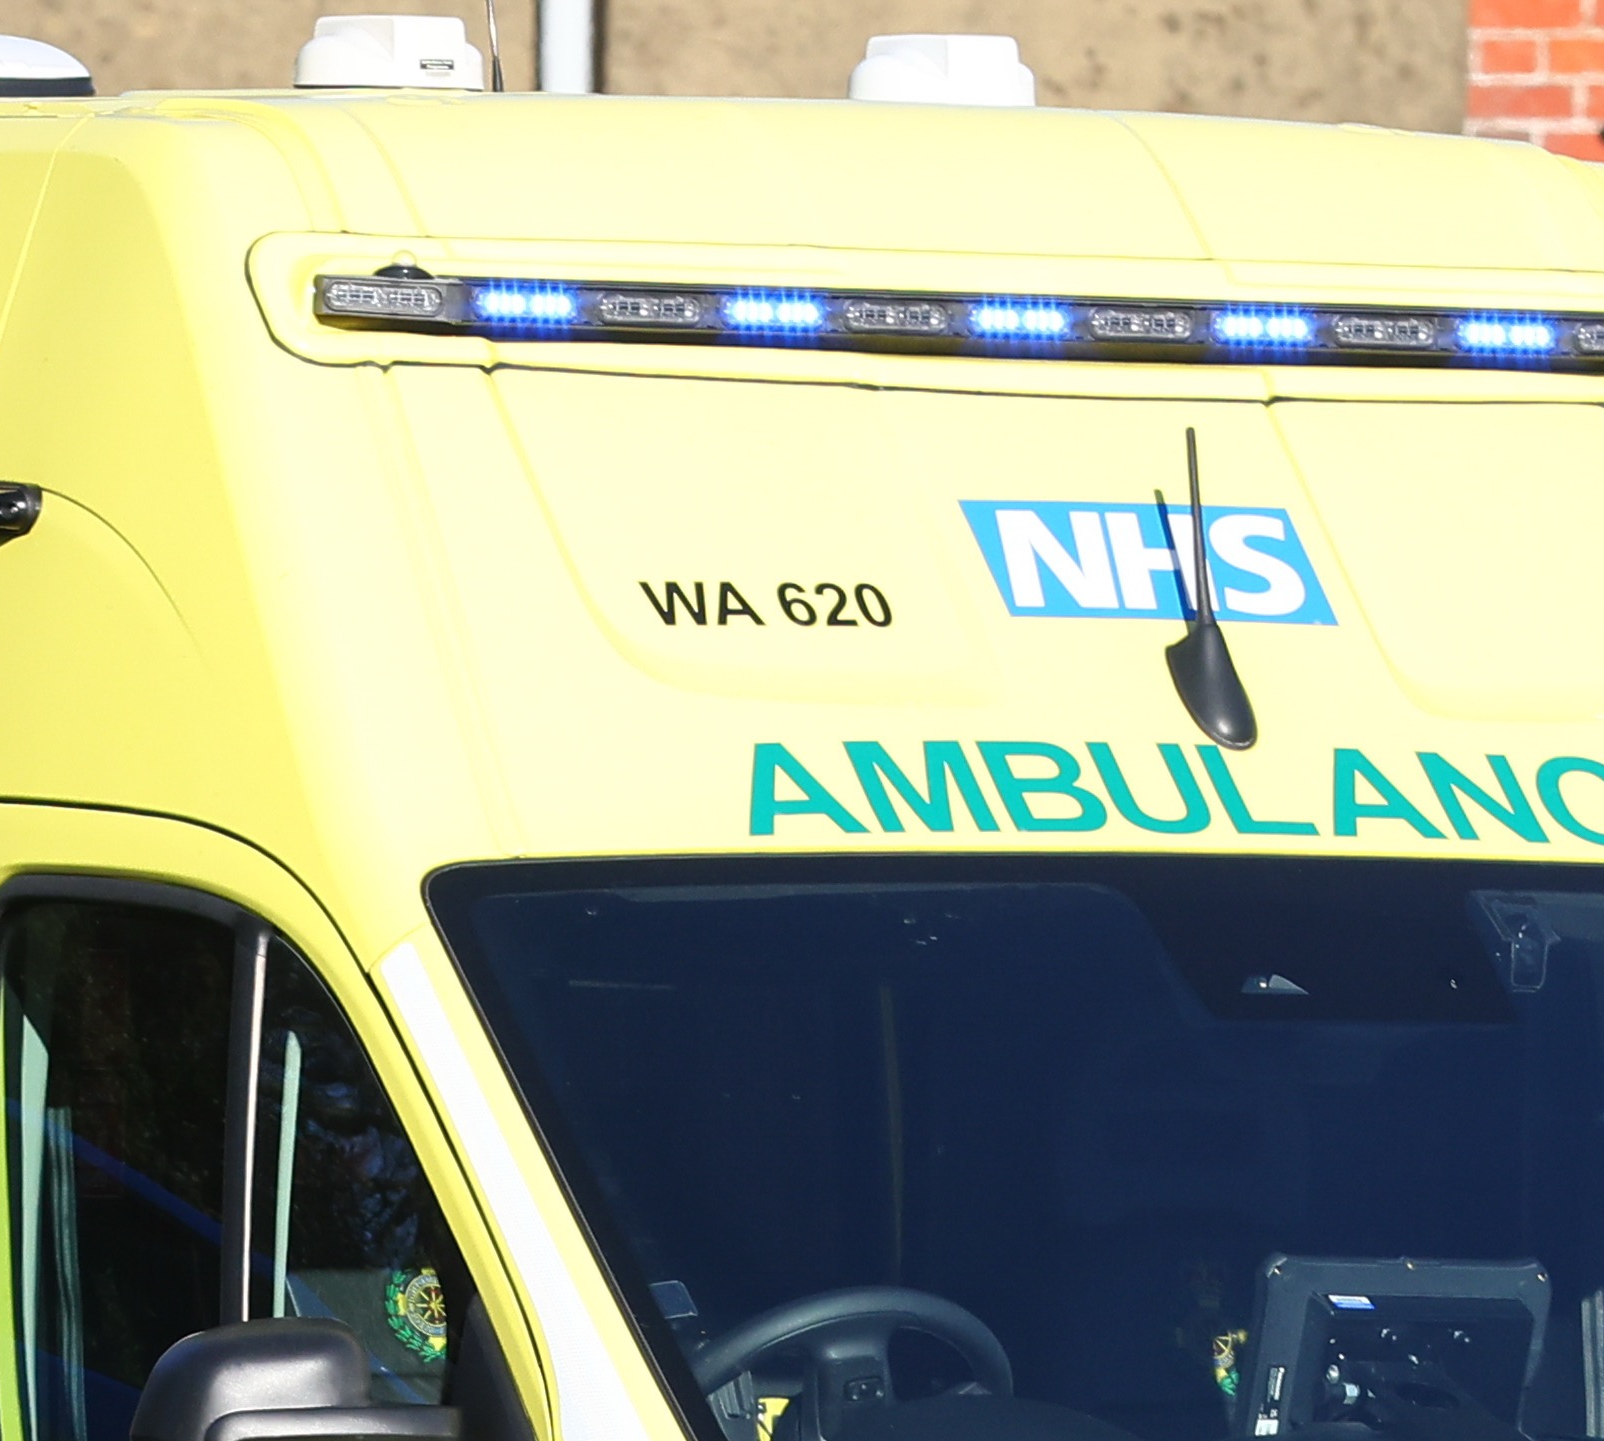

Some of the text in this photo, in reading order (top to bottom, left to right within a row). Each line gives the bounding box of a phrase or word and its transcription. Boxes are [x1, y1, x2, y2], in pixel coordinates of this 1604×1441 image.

[995, 510, 1307, 617] NHS
[638, 581, 893, 628] WA 620
